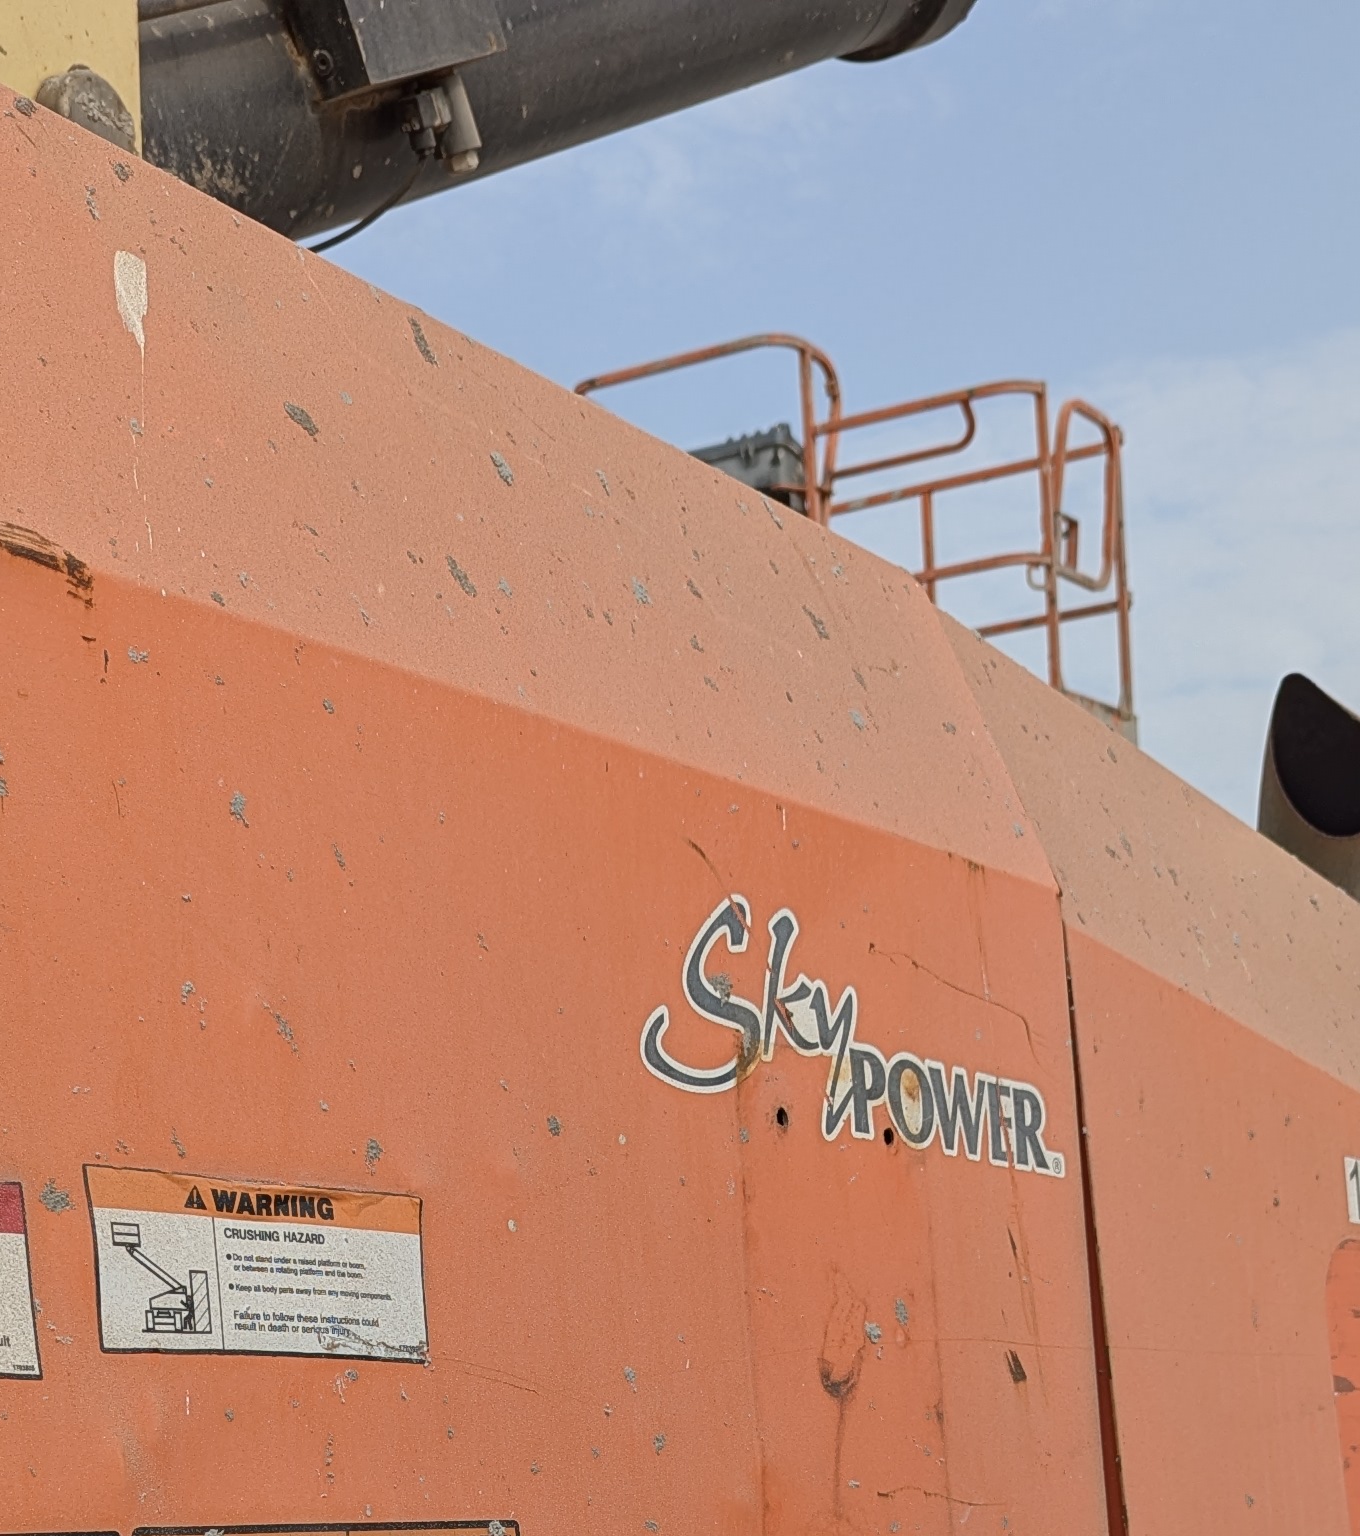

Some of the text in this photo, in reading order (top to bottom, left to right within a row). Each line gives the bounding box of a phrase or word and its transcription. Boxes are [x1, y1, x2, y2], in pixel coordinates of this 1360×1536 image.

[640, 893, 857, 1141] Sky
[210, 1188, 335, 1220] WARNING
[224, 1228, 325, 1245] CRUSHING HAZARD
[234, 1310, 261, 1320] Failure
[263, 1311, 270, 1320] to
[273, 1312, 294, 1322] follow
[297, 1313, 318, 1323] these
[320, 1314, 360, 1325] instructions
[234, 1322, 256, 1331] result
[259, 1322, 265, 1331] in
[268, 1323, 289, 1332] death
[292, 1325, 299, 1333] or
[302, 1325, 329, 1334] serious
